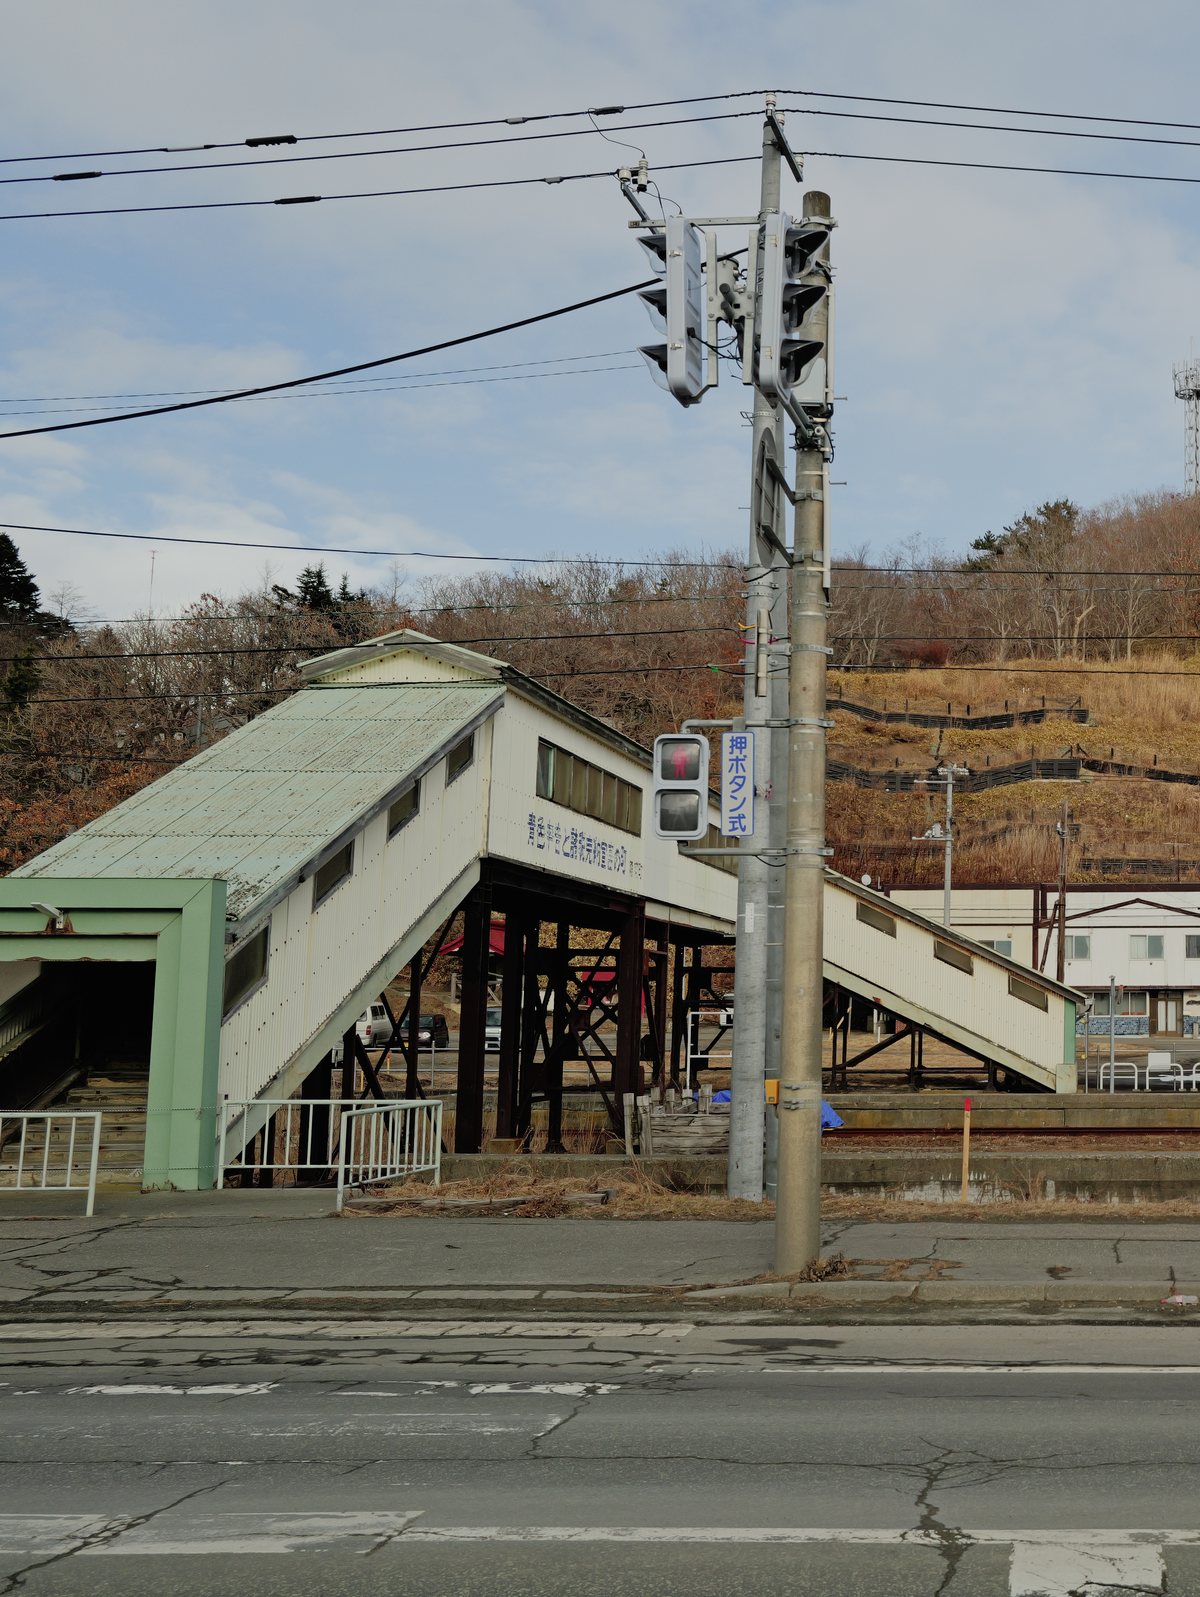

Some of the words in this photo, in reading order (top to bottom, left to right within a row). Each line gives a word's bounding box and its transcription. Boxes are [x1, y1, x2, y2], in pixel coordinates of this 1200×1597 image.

[728, 735, 747, 833] 押ボタン式
